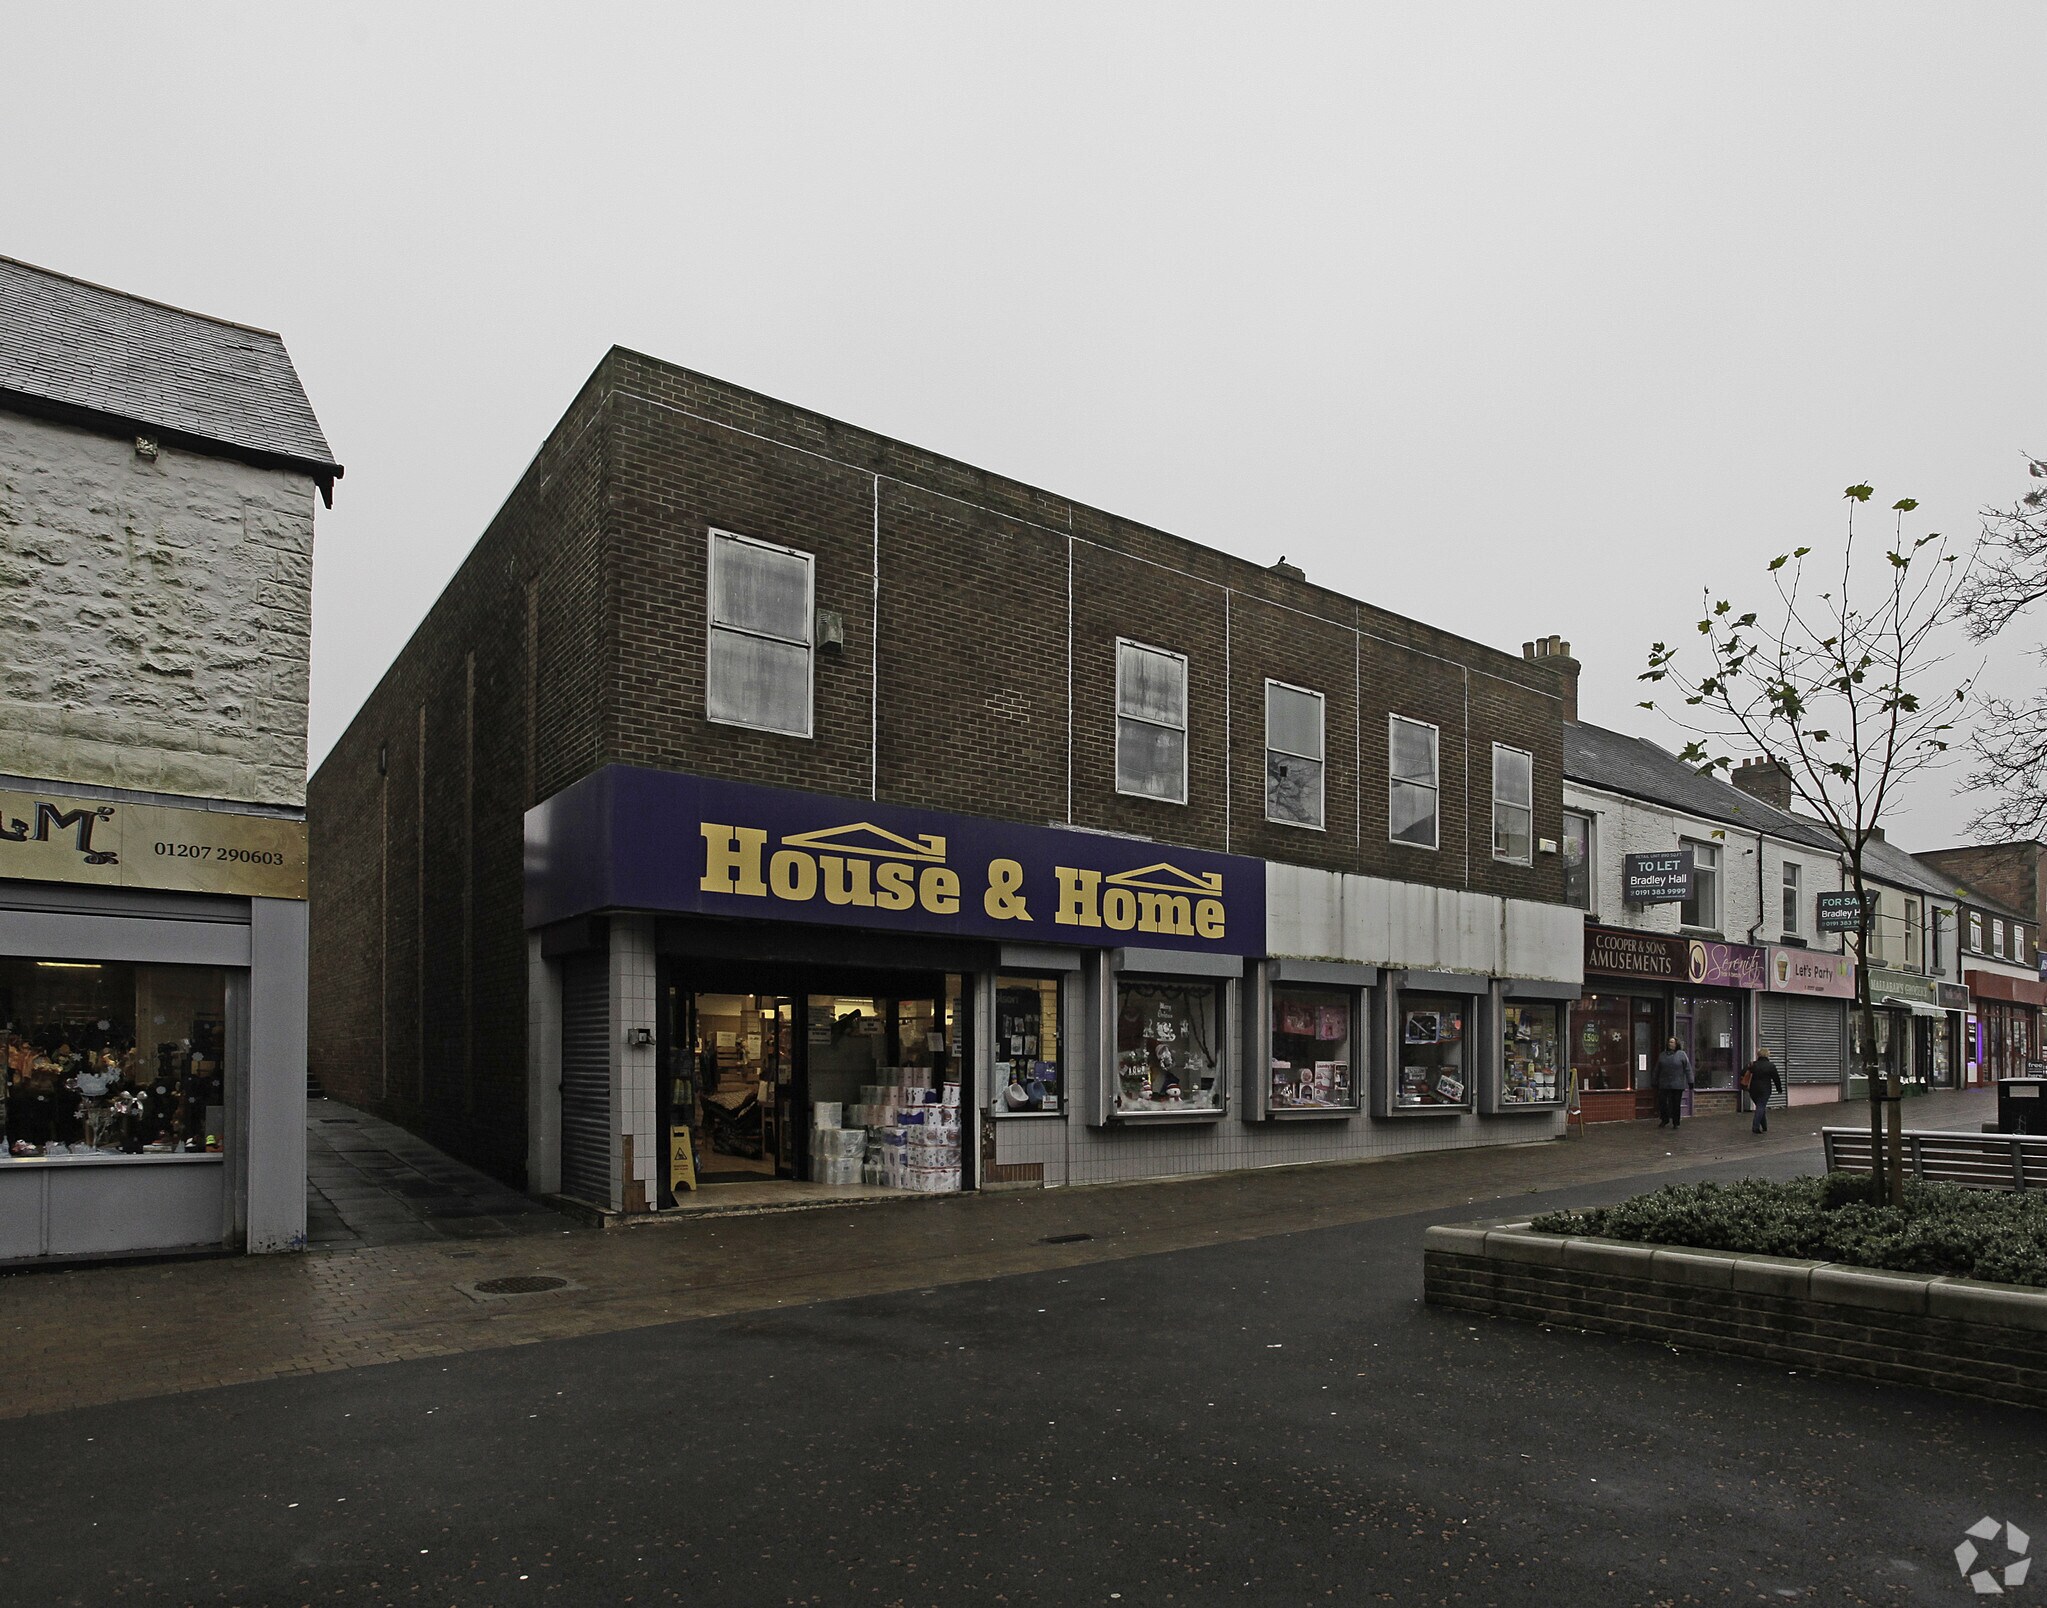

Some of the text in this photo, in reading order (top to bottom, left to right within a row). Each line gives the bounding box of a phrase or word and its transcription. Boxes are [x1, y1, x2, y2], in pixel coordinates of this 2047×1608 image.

[154, 841, 284, 865] 01207 290603
[1638, 860, 1681, 872] TO LET
[699, 821, 1226, 940] House & Home
[1630, 873, 1687, 887] Bradley Hall
[1651, 888, 1666, 896] 383
[1667, 887, 1686, 895] 9999
[1822, 896, 1871, 907] FOR SAE
[1821, 909, 1852, 919] Bradley
[1638, 941, 1645, 953] &
[1646, 941, 1667, 956] SONS
[1589, 949, 1672, 974] AMUSEMENTS
[1707, 944, 1764, 988] Serenity
[1795, 963, 1833, 982] Let's Party
